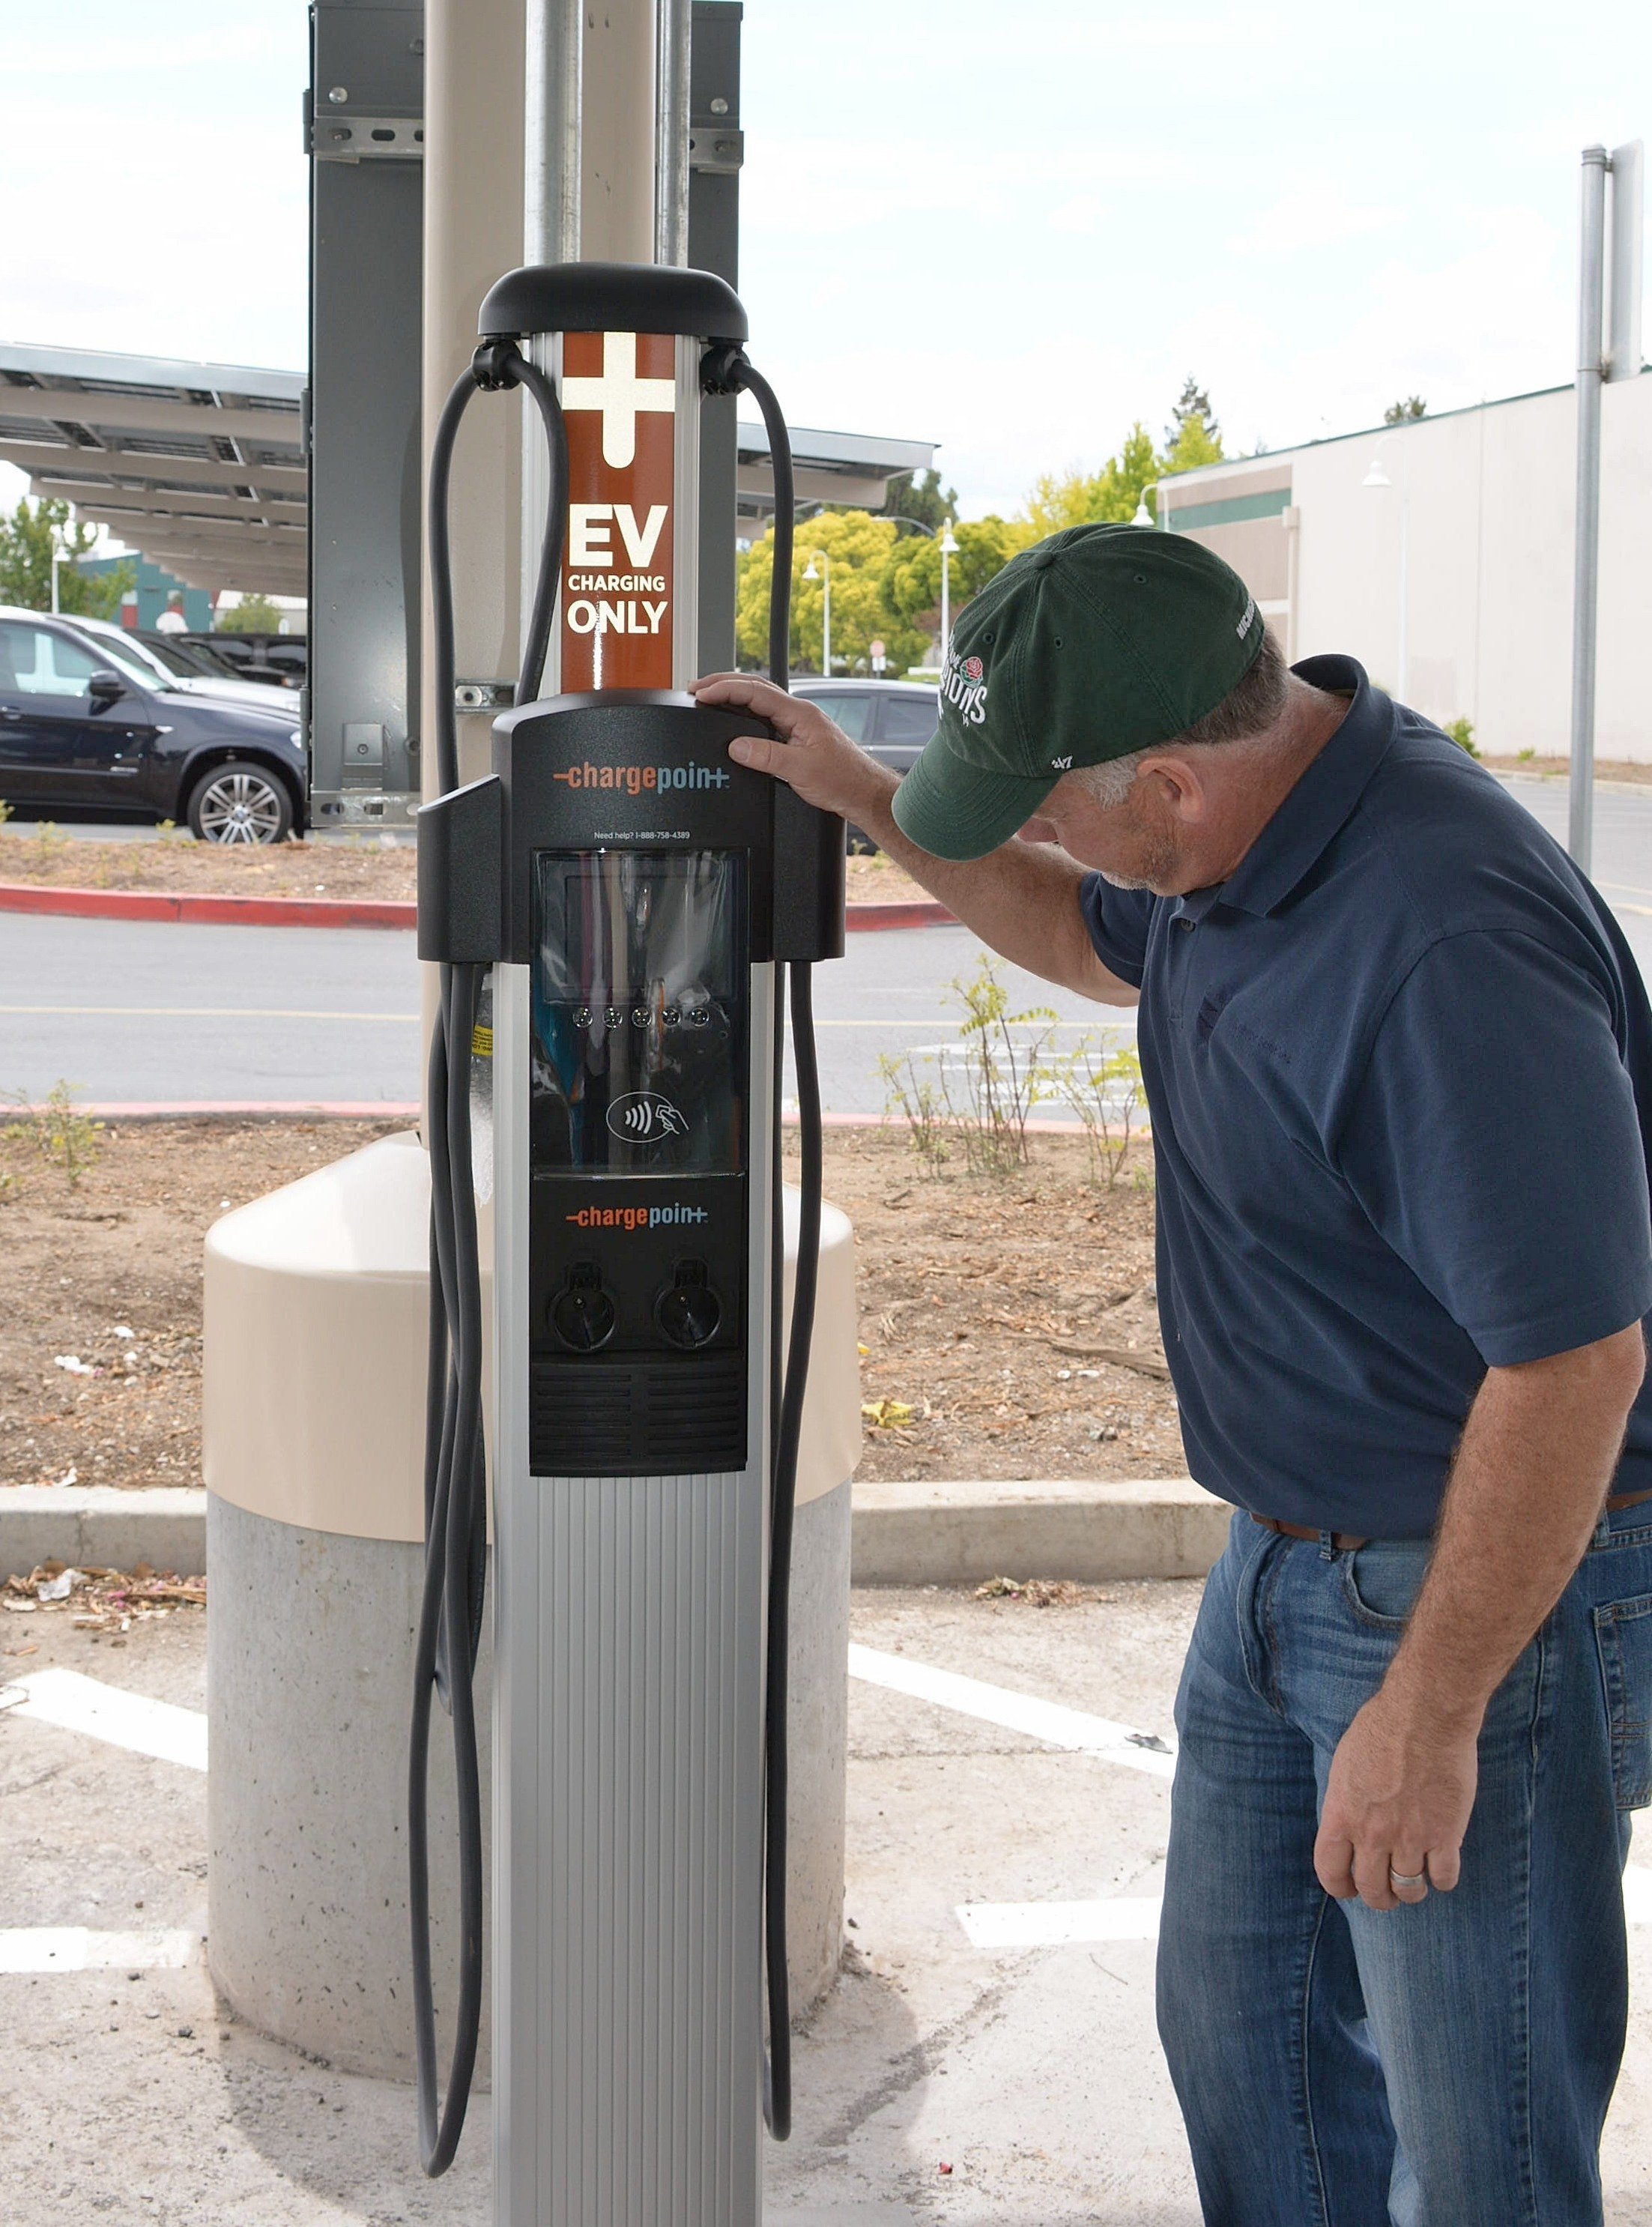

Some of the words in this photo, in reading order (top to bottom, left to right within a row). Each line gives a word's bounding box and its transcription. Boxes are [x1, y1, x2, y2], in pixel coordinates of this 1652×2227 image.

[569, 504, 668, 567] EV
[568, 574, 665, 592] CHARGING
[567, 600, 668, 634] ONLY
[594, 831, 613, 839] Need
[614, 831, 634, 841] help?
[635, 831, 691, 839] 1-888-758-4389
